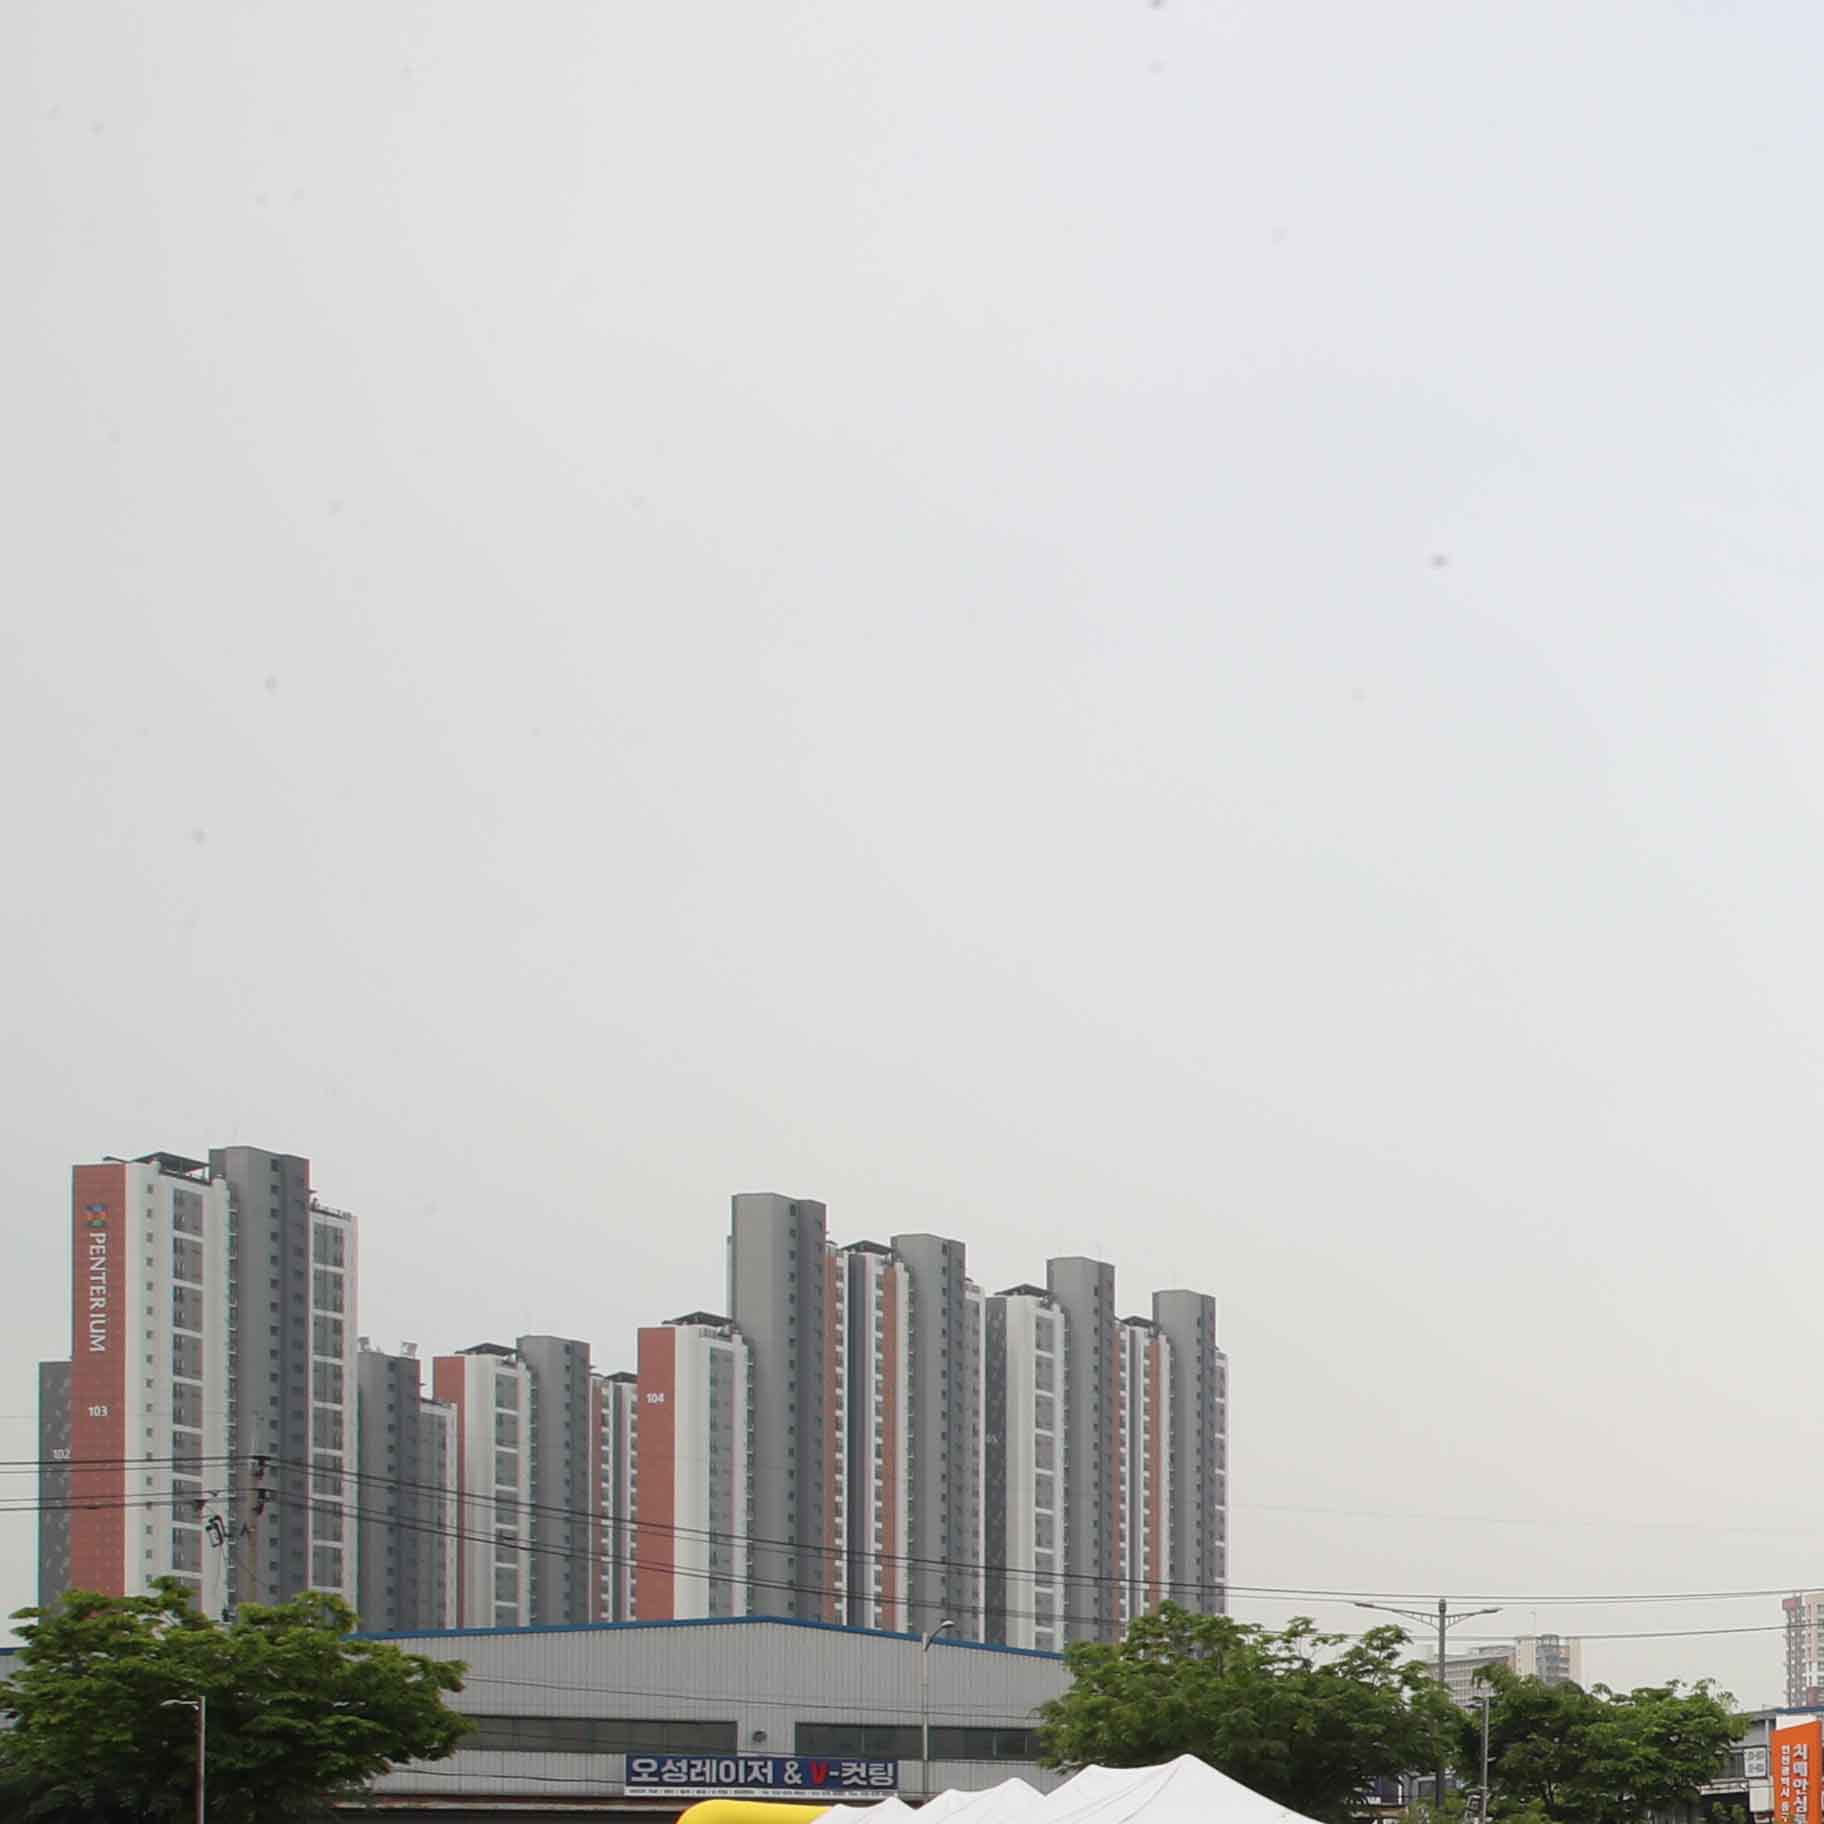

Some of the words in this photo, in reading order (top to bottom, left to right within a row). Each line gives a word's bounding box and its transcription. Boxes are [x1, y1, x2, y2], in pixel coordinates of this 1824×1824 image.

[89, 1232, 109, 1353] PENTERIUM
[87, 1407, 108, 1417] 103
[631, 1758, 774, 1784] 오성레이저
[783, 1761, 804, 1785] &
